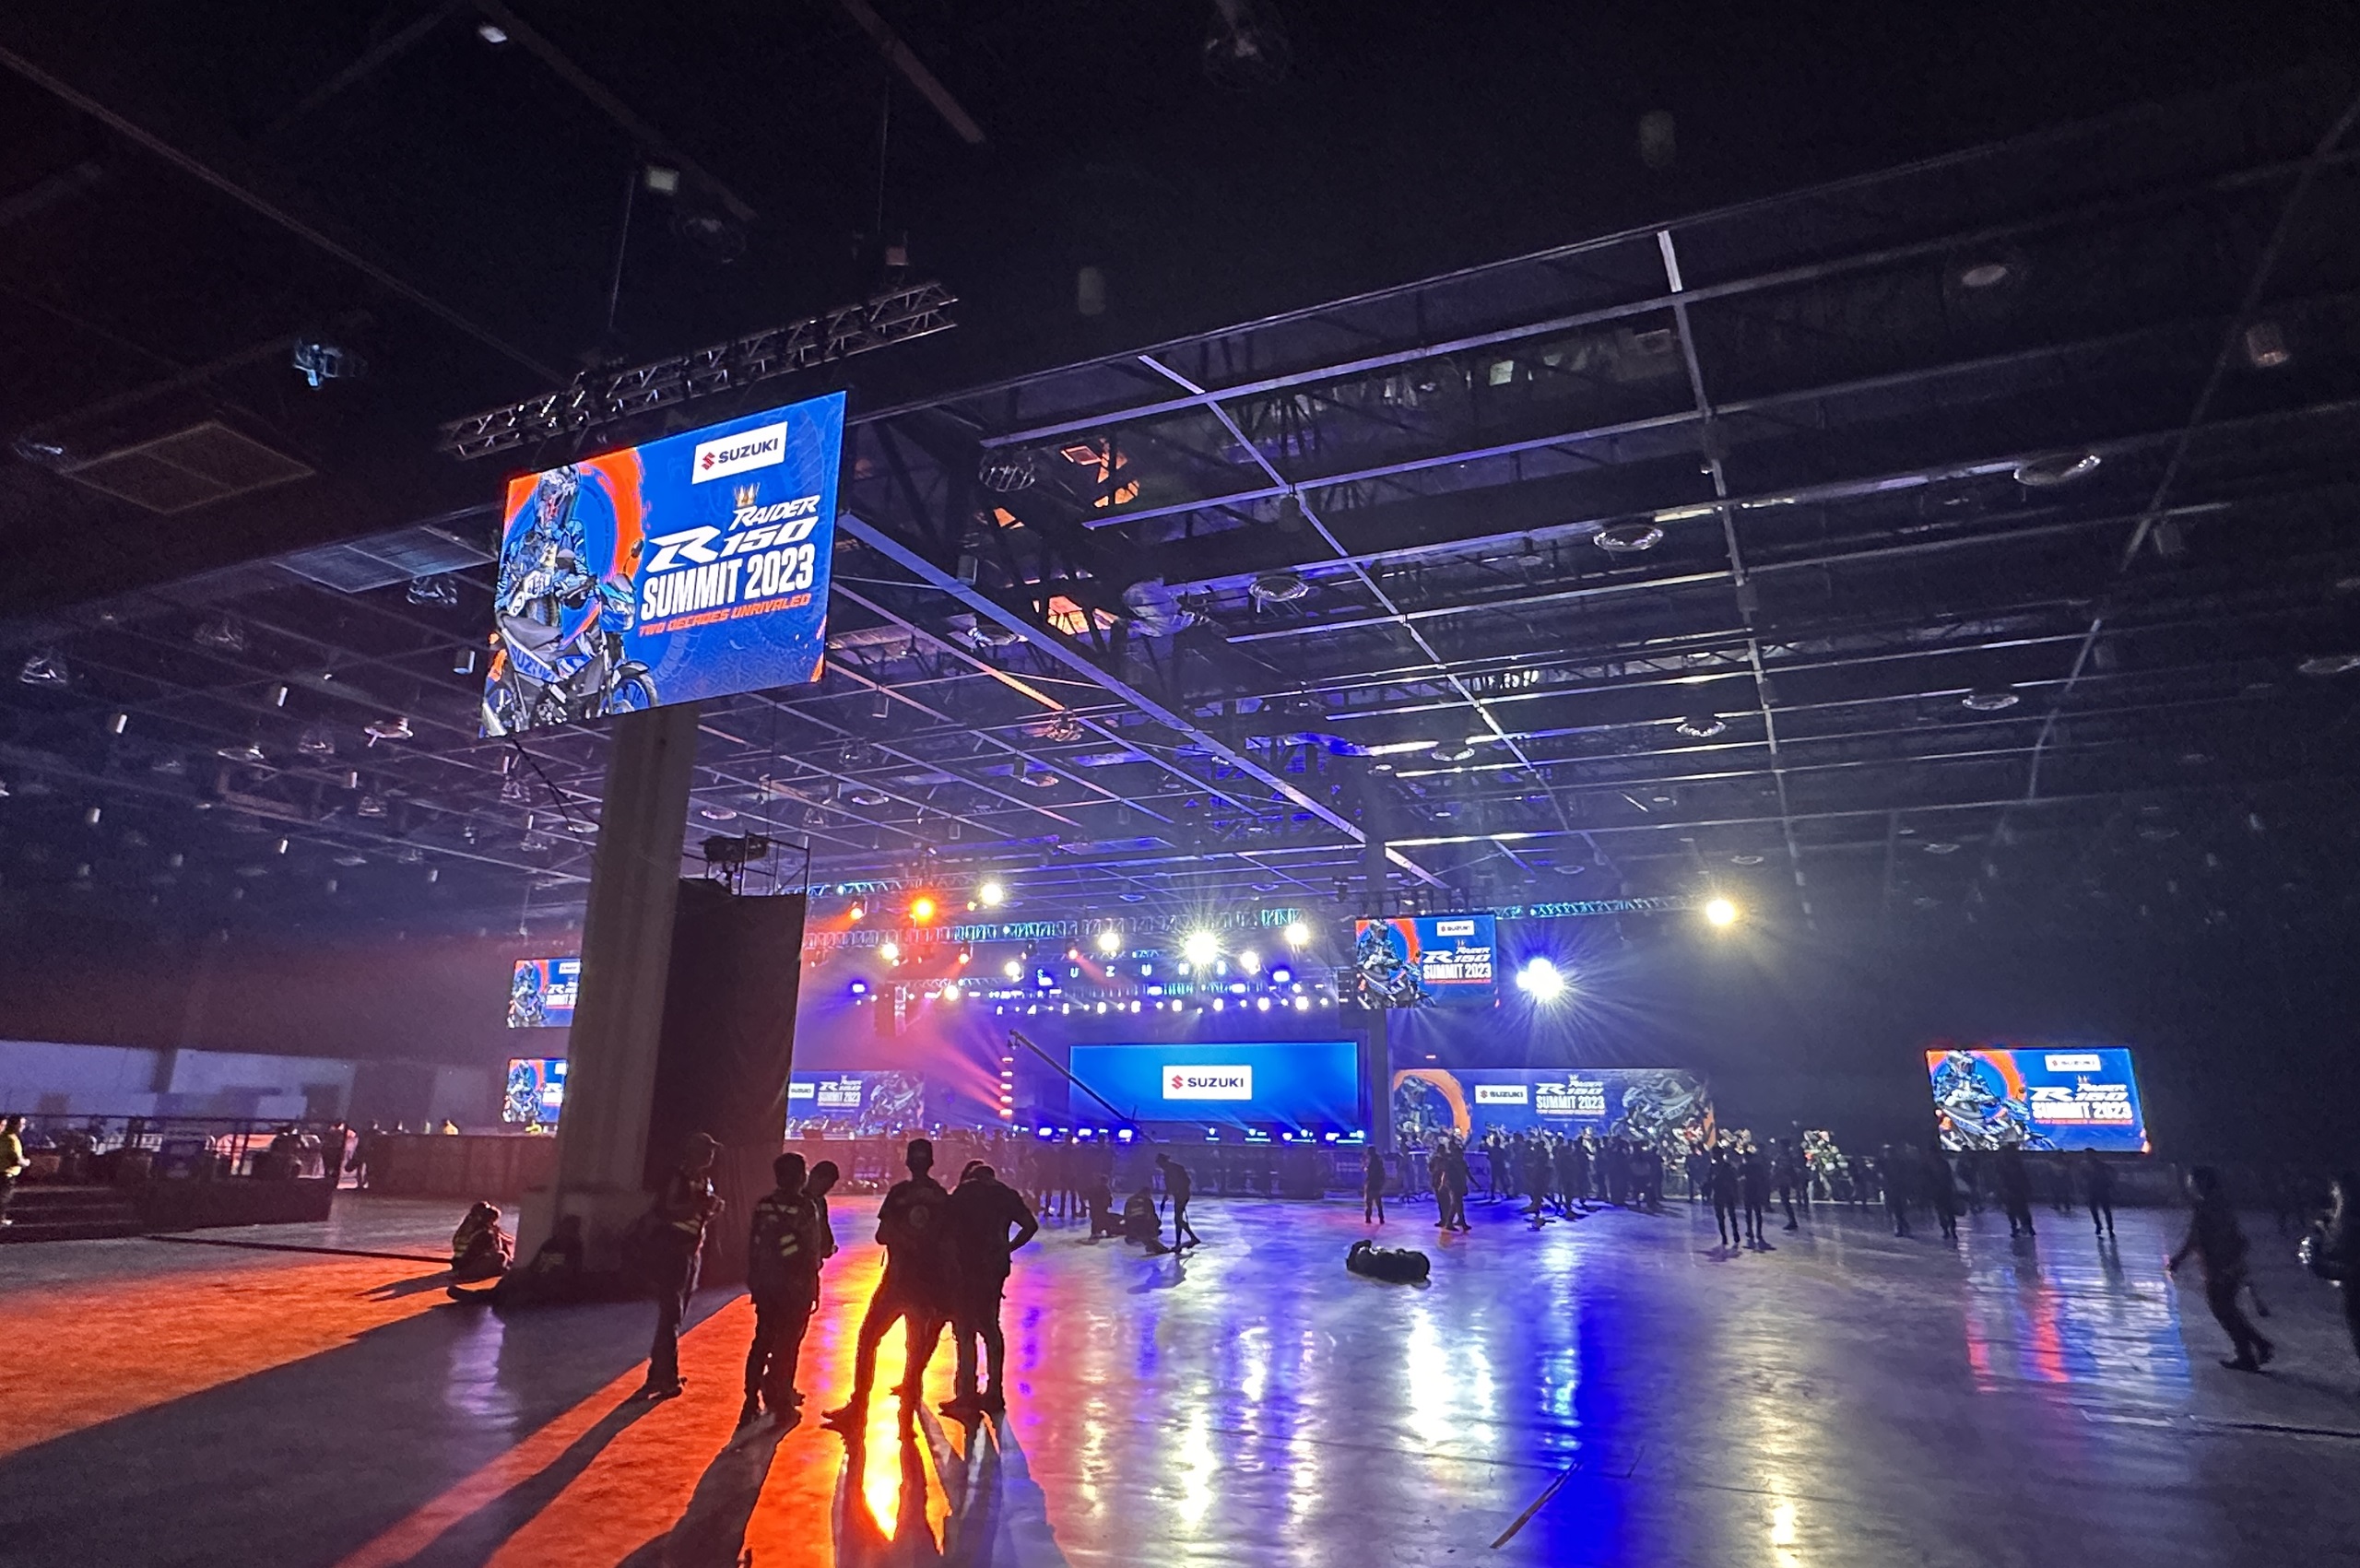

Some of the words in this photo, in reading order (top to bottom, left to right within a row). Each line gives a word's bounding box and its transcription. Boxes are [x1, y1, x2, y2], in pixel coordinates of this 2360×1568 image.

[718, 438, 778, 464] SUZUKI
[728, 495, 820, 531] RAIDER
[641, 558, 743, 620] SUMMIT
[744, 543, 815, 599] 2023
[639, 621, 666, 638] TWO
[667, 608, 730, 631] DECADES
[731, 593, 811, 619] UNRIVALED
[1422, 963, 1463, 979] SUMMIT
[1464, 962, 1492, 979] 2023
[1187, 1077, 1244, 1088] SUZUKI
[1536, 1096, 1576, 1109] SUMMIT
[1577, 1096, 1605, 1110] 2023
[2031, 1102, 2090, 1119] SUMMIT
[2092, 1102, 2133, 1119] 2023
